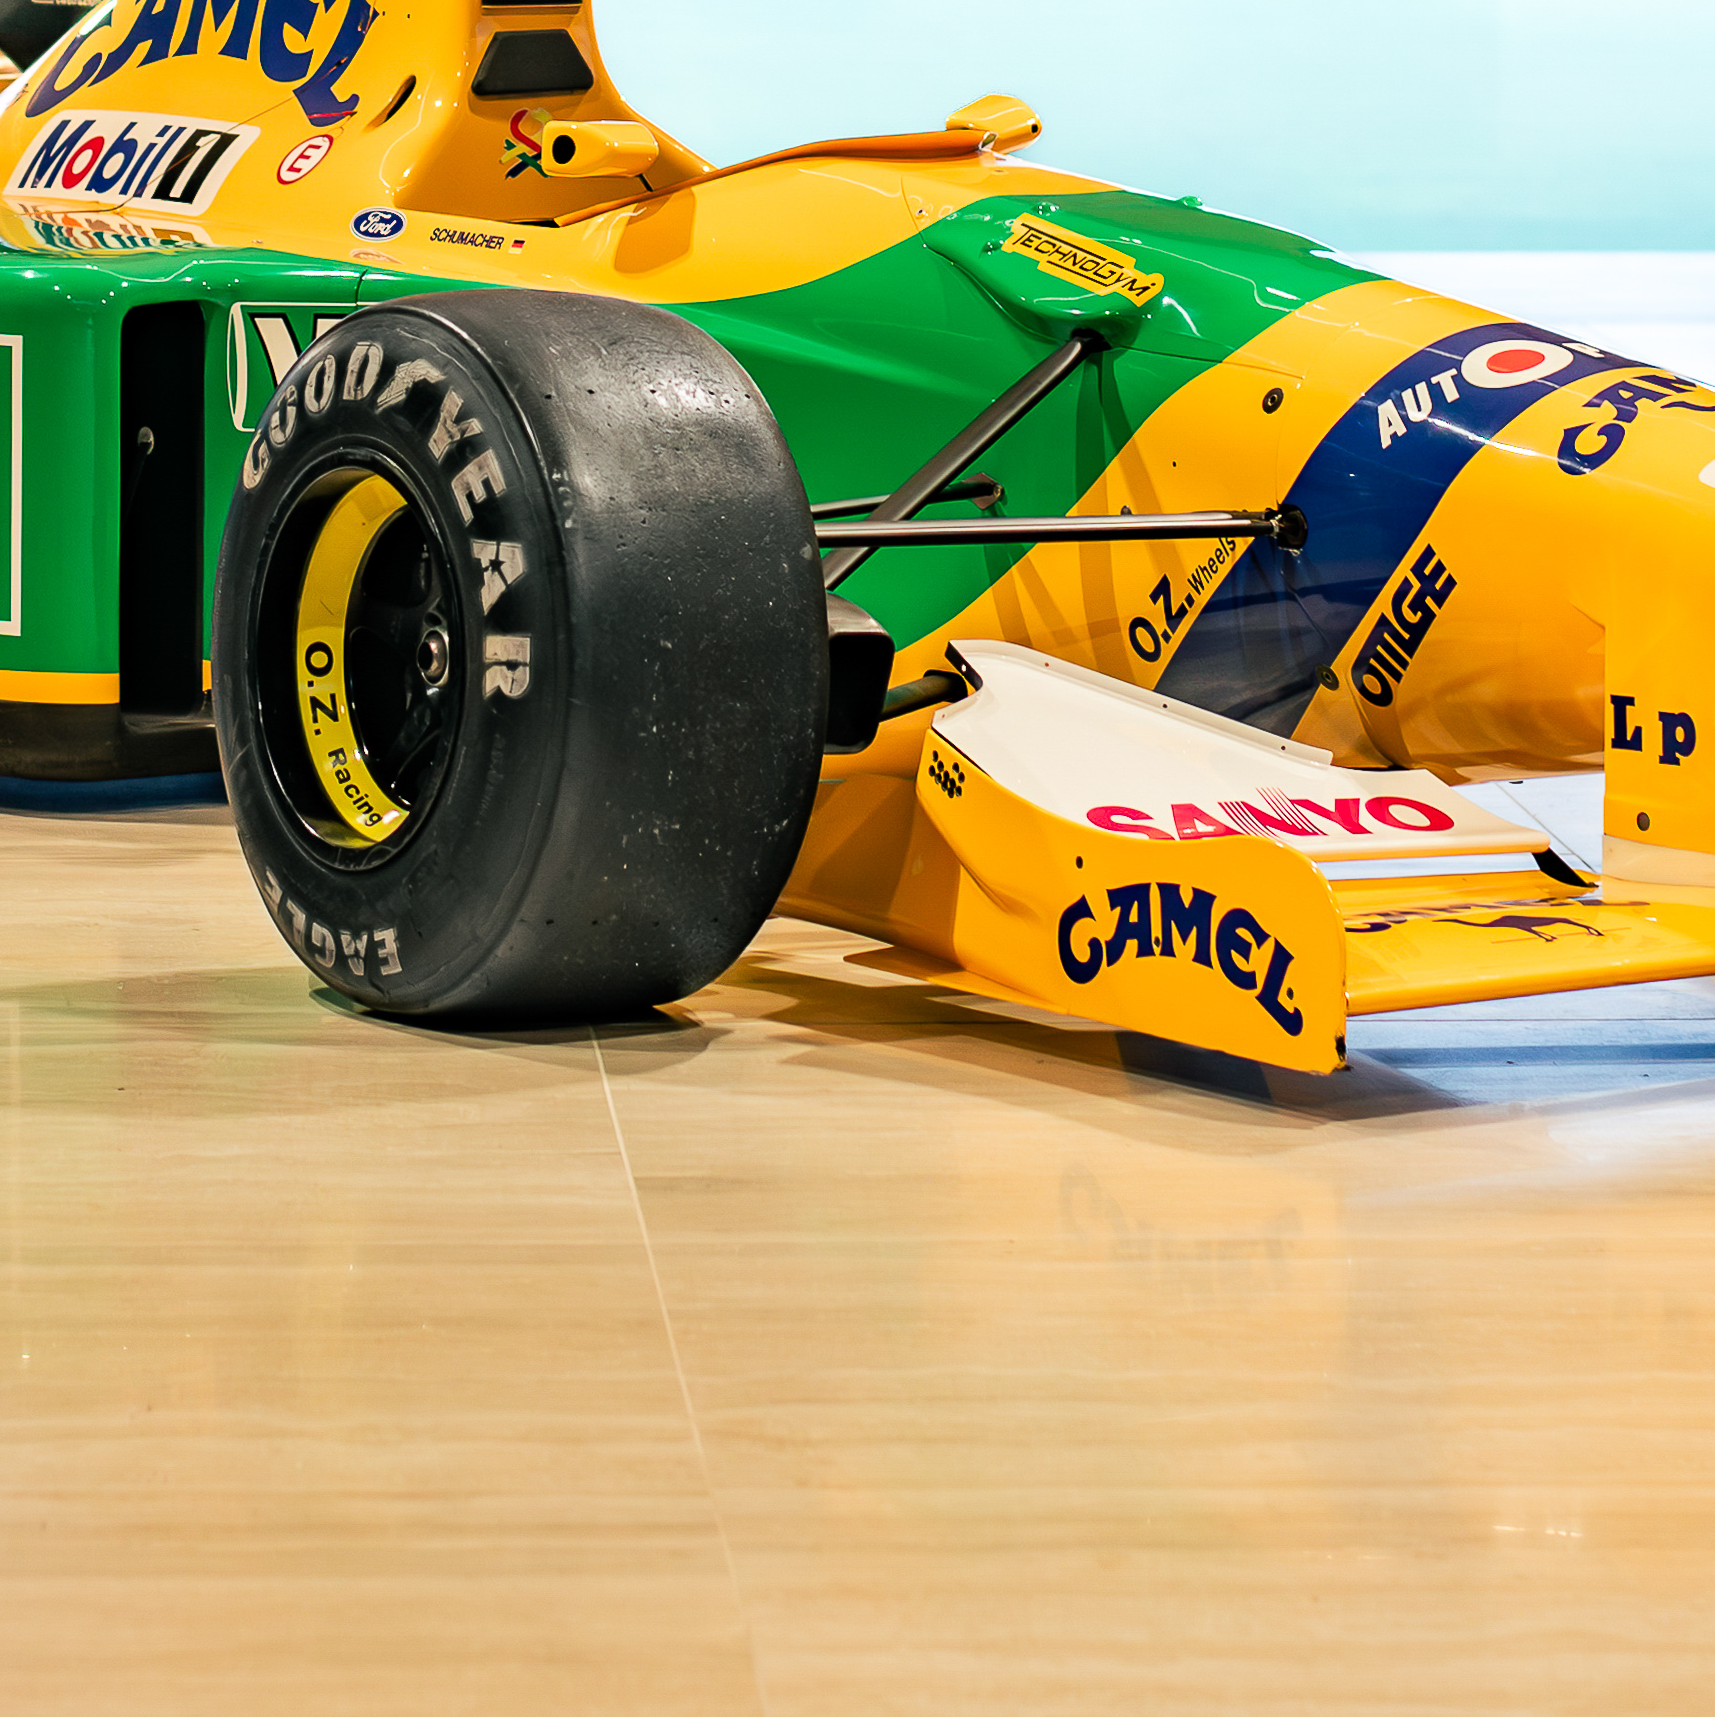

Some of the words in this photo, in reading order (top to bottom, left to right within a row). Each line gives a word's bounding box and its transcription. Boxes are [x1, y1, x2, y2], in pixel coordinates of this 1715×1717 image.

[18, 119, 187, 198] Mobil
[166, 132, 224, 199] 1
[286, 143, 322, 174] E
[358, 211, 398, 235] Ford
[429, 227, 505, 251] SCHUMACHER
[242, 341, 531, 700] GOODYEAR
[1128, 573, 1196, 663] O.Z.
[1186, 537, 1237, 596] Wheels
[304, 640, 340, 736] O.Z.
[327, 747, 383, 828] Racing
[1086, 790, 1455, 841] SANYO
[1057, 881, 1304, 1037] CAMEL
